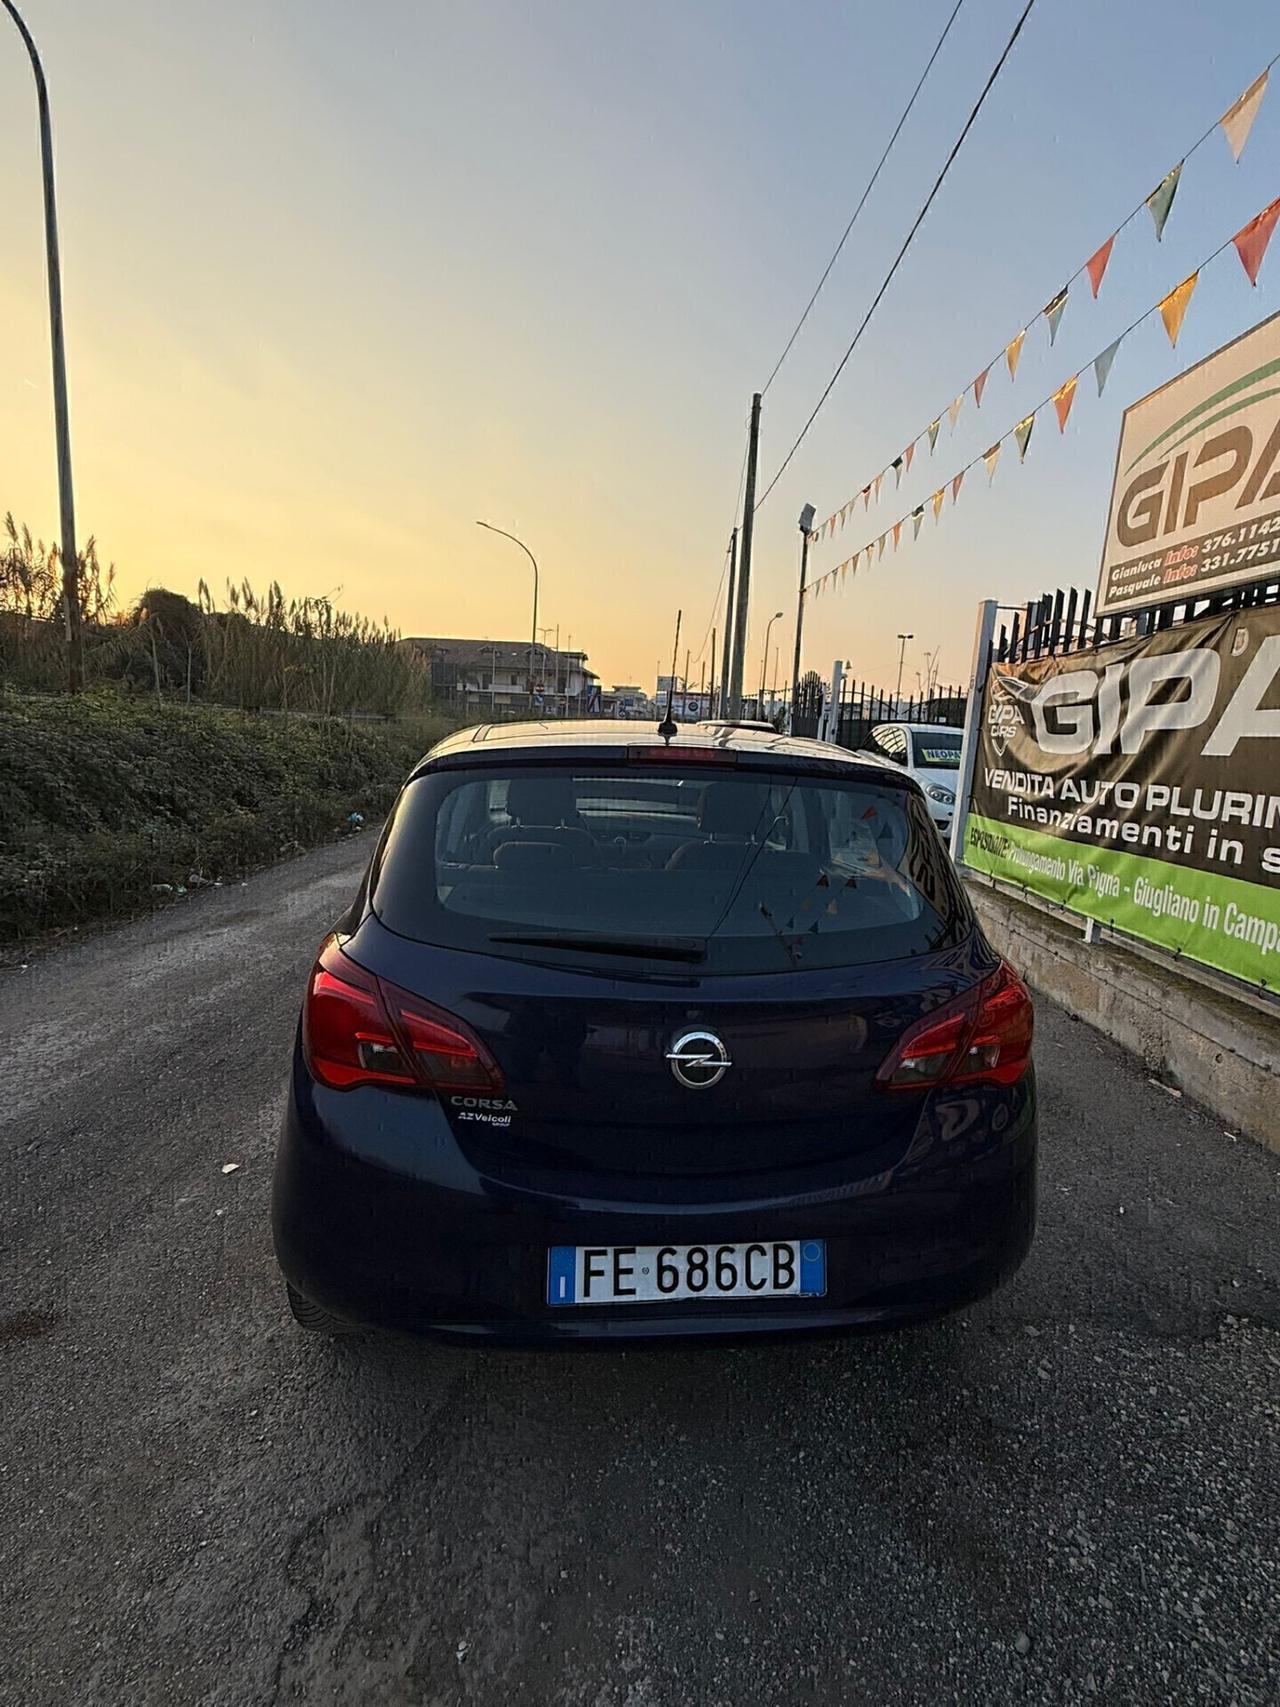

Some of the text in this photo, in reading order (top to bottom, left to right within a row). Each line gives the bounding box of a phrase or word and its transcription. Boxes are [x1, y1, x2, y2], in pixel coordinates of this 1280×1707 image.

[1108, 573, 1161, 598] Pasquale
[1163, 563, 1198, 584] Info:
[1111, 557, 1162, 581] Gianluca
[1164, 544, 1199, 566] Info:
[984, 767, 1054, 799] VENDITA
[1060, 778, 1141, 809] AUTO
[1007, 796, 1195, 854] Finanziamenti
[1207, 828, 1244, 865] in
[1068, 858, 1085, 887] Via
[1087, 863, 1120, 898] Pigna
[1133, 876, 1200, 924] Giugliano
[1203, 896, 1220, 930] in
[1223, 902, 1280, 956] Camp
[451, 1095, 518, 1111] CORSA
[583, 1247, 637, 1298] FE
[656, 1242, 795, 1293] 686CB
